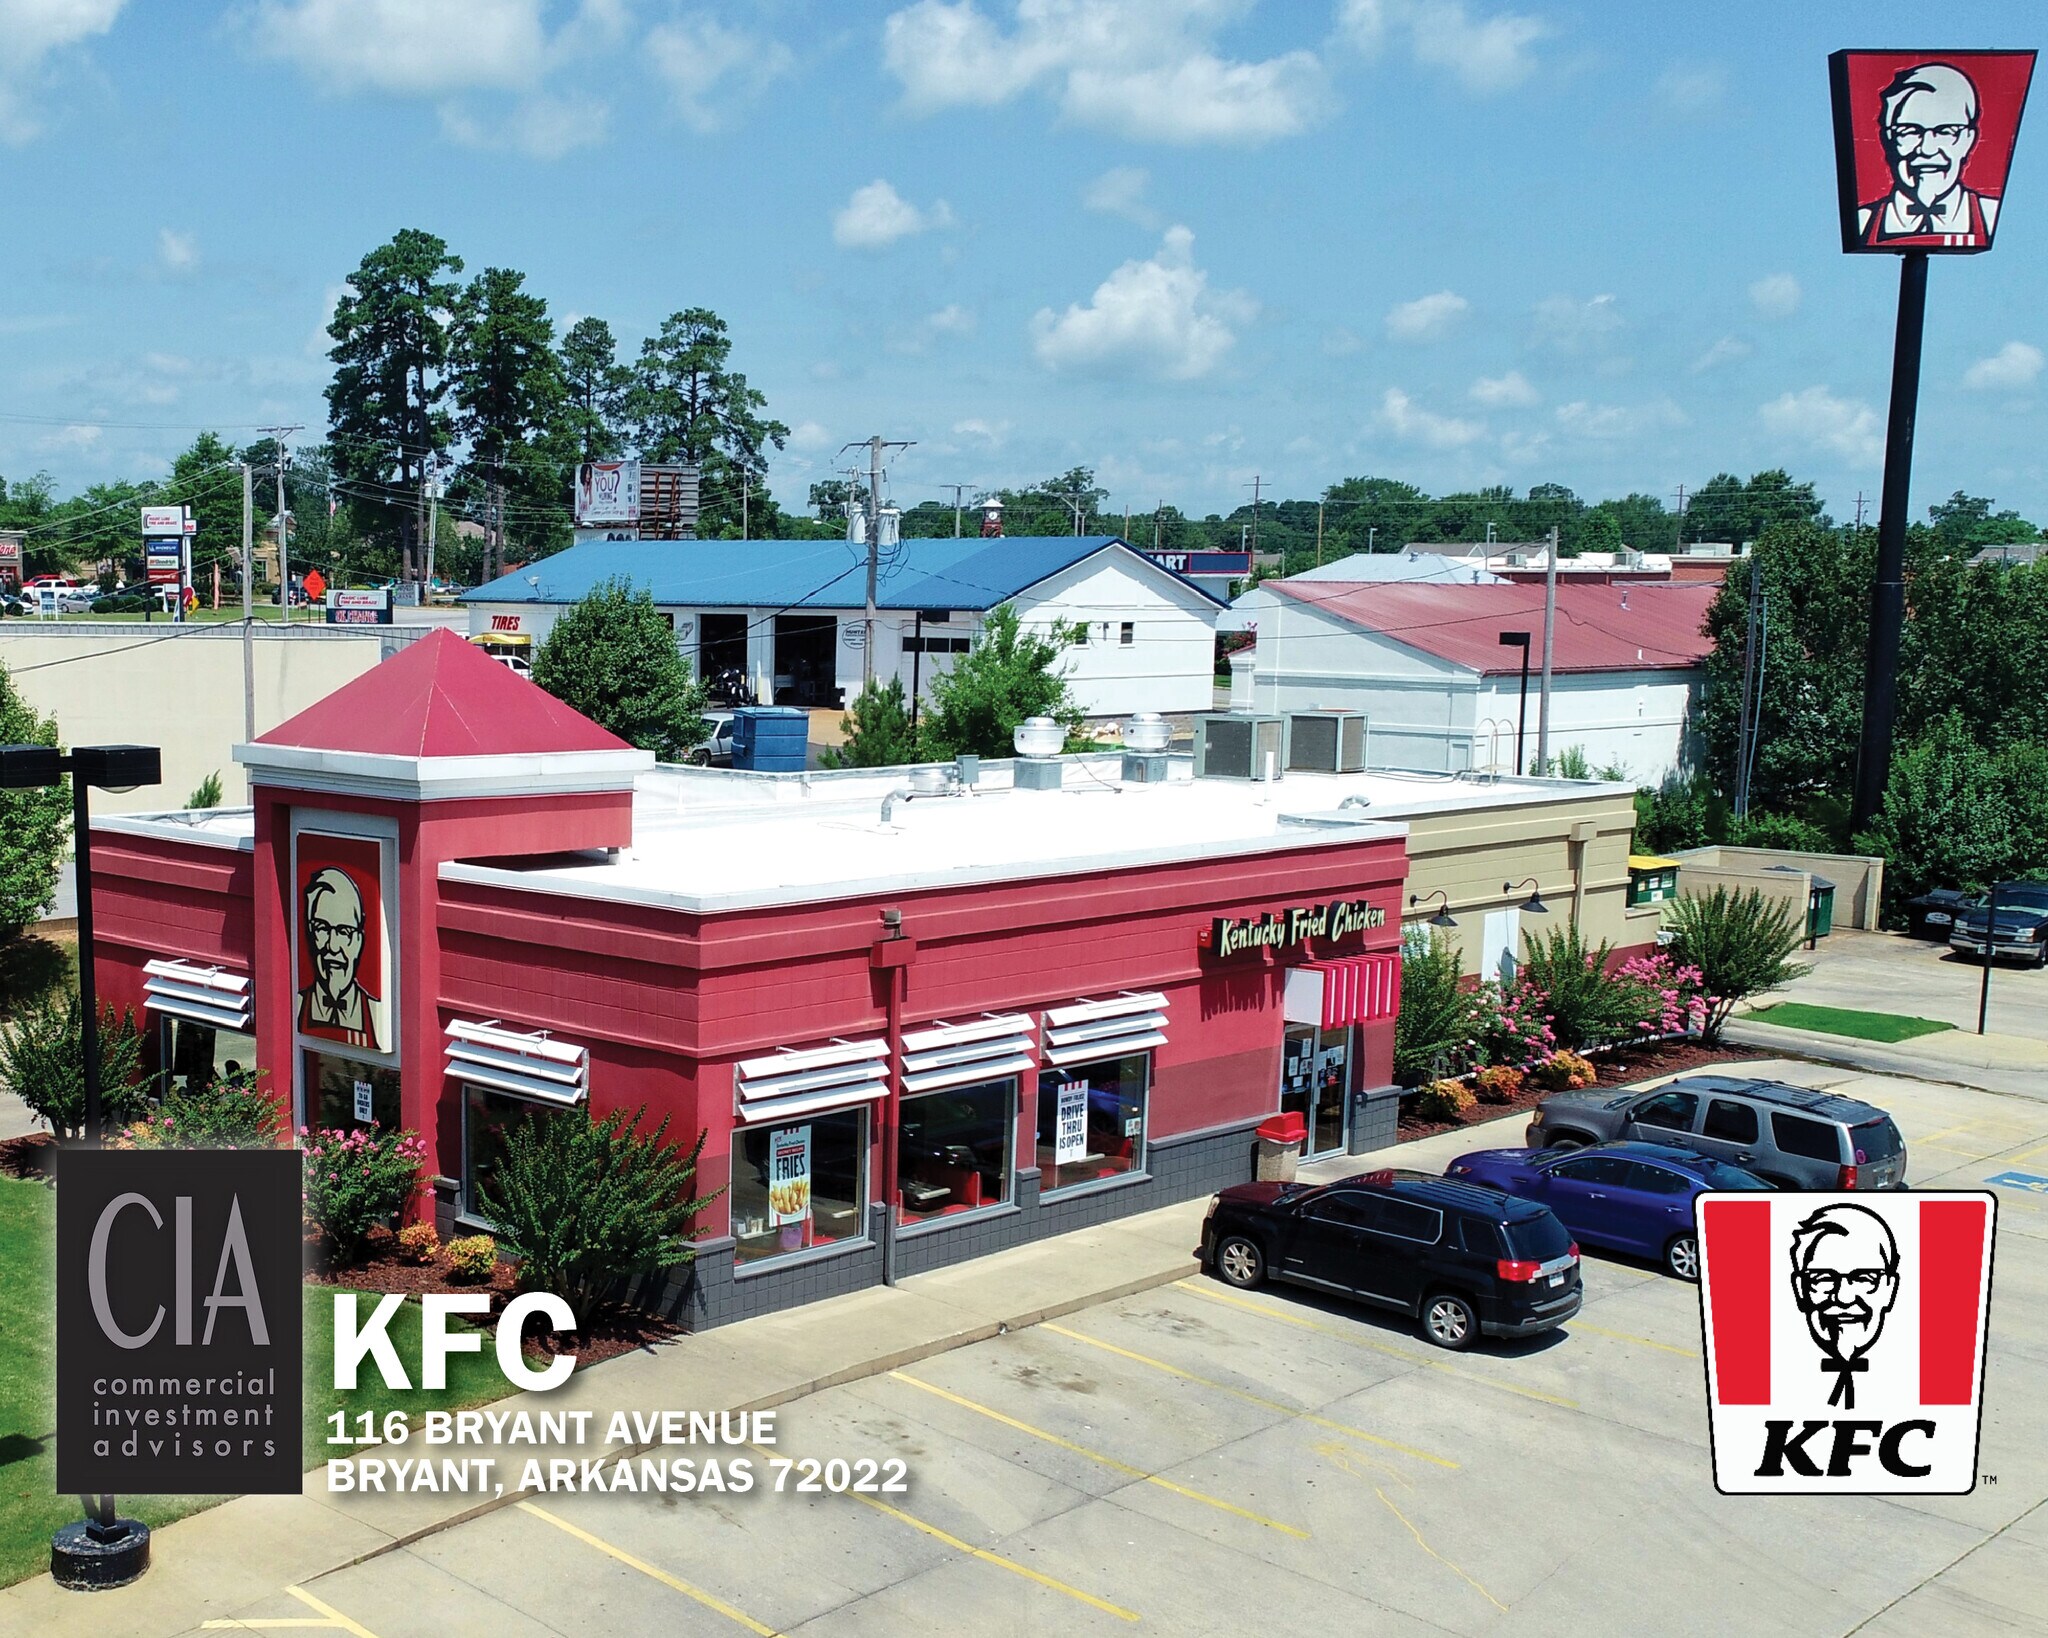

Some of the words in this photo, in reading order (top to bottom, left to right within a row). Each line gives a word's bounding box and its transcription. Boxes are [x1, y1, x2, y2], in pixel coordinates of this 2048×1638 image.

[491, 615, 521, 631] TIRES
[1220, 914, 1286, 957] Kentucky
[1291, 905, 1327, 946] Fried
[1332, 902, 1386, 942] Chicken
[1061, 1103, 1084, 1121] DRIVE
[1062, 1119, 1083, 1135] THRU
[1059, 1137, 1066, 1150] IS
[1066, 1133, 1085, 1148] OPEN
[776, 1153, 805, 1181] FRIES
